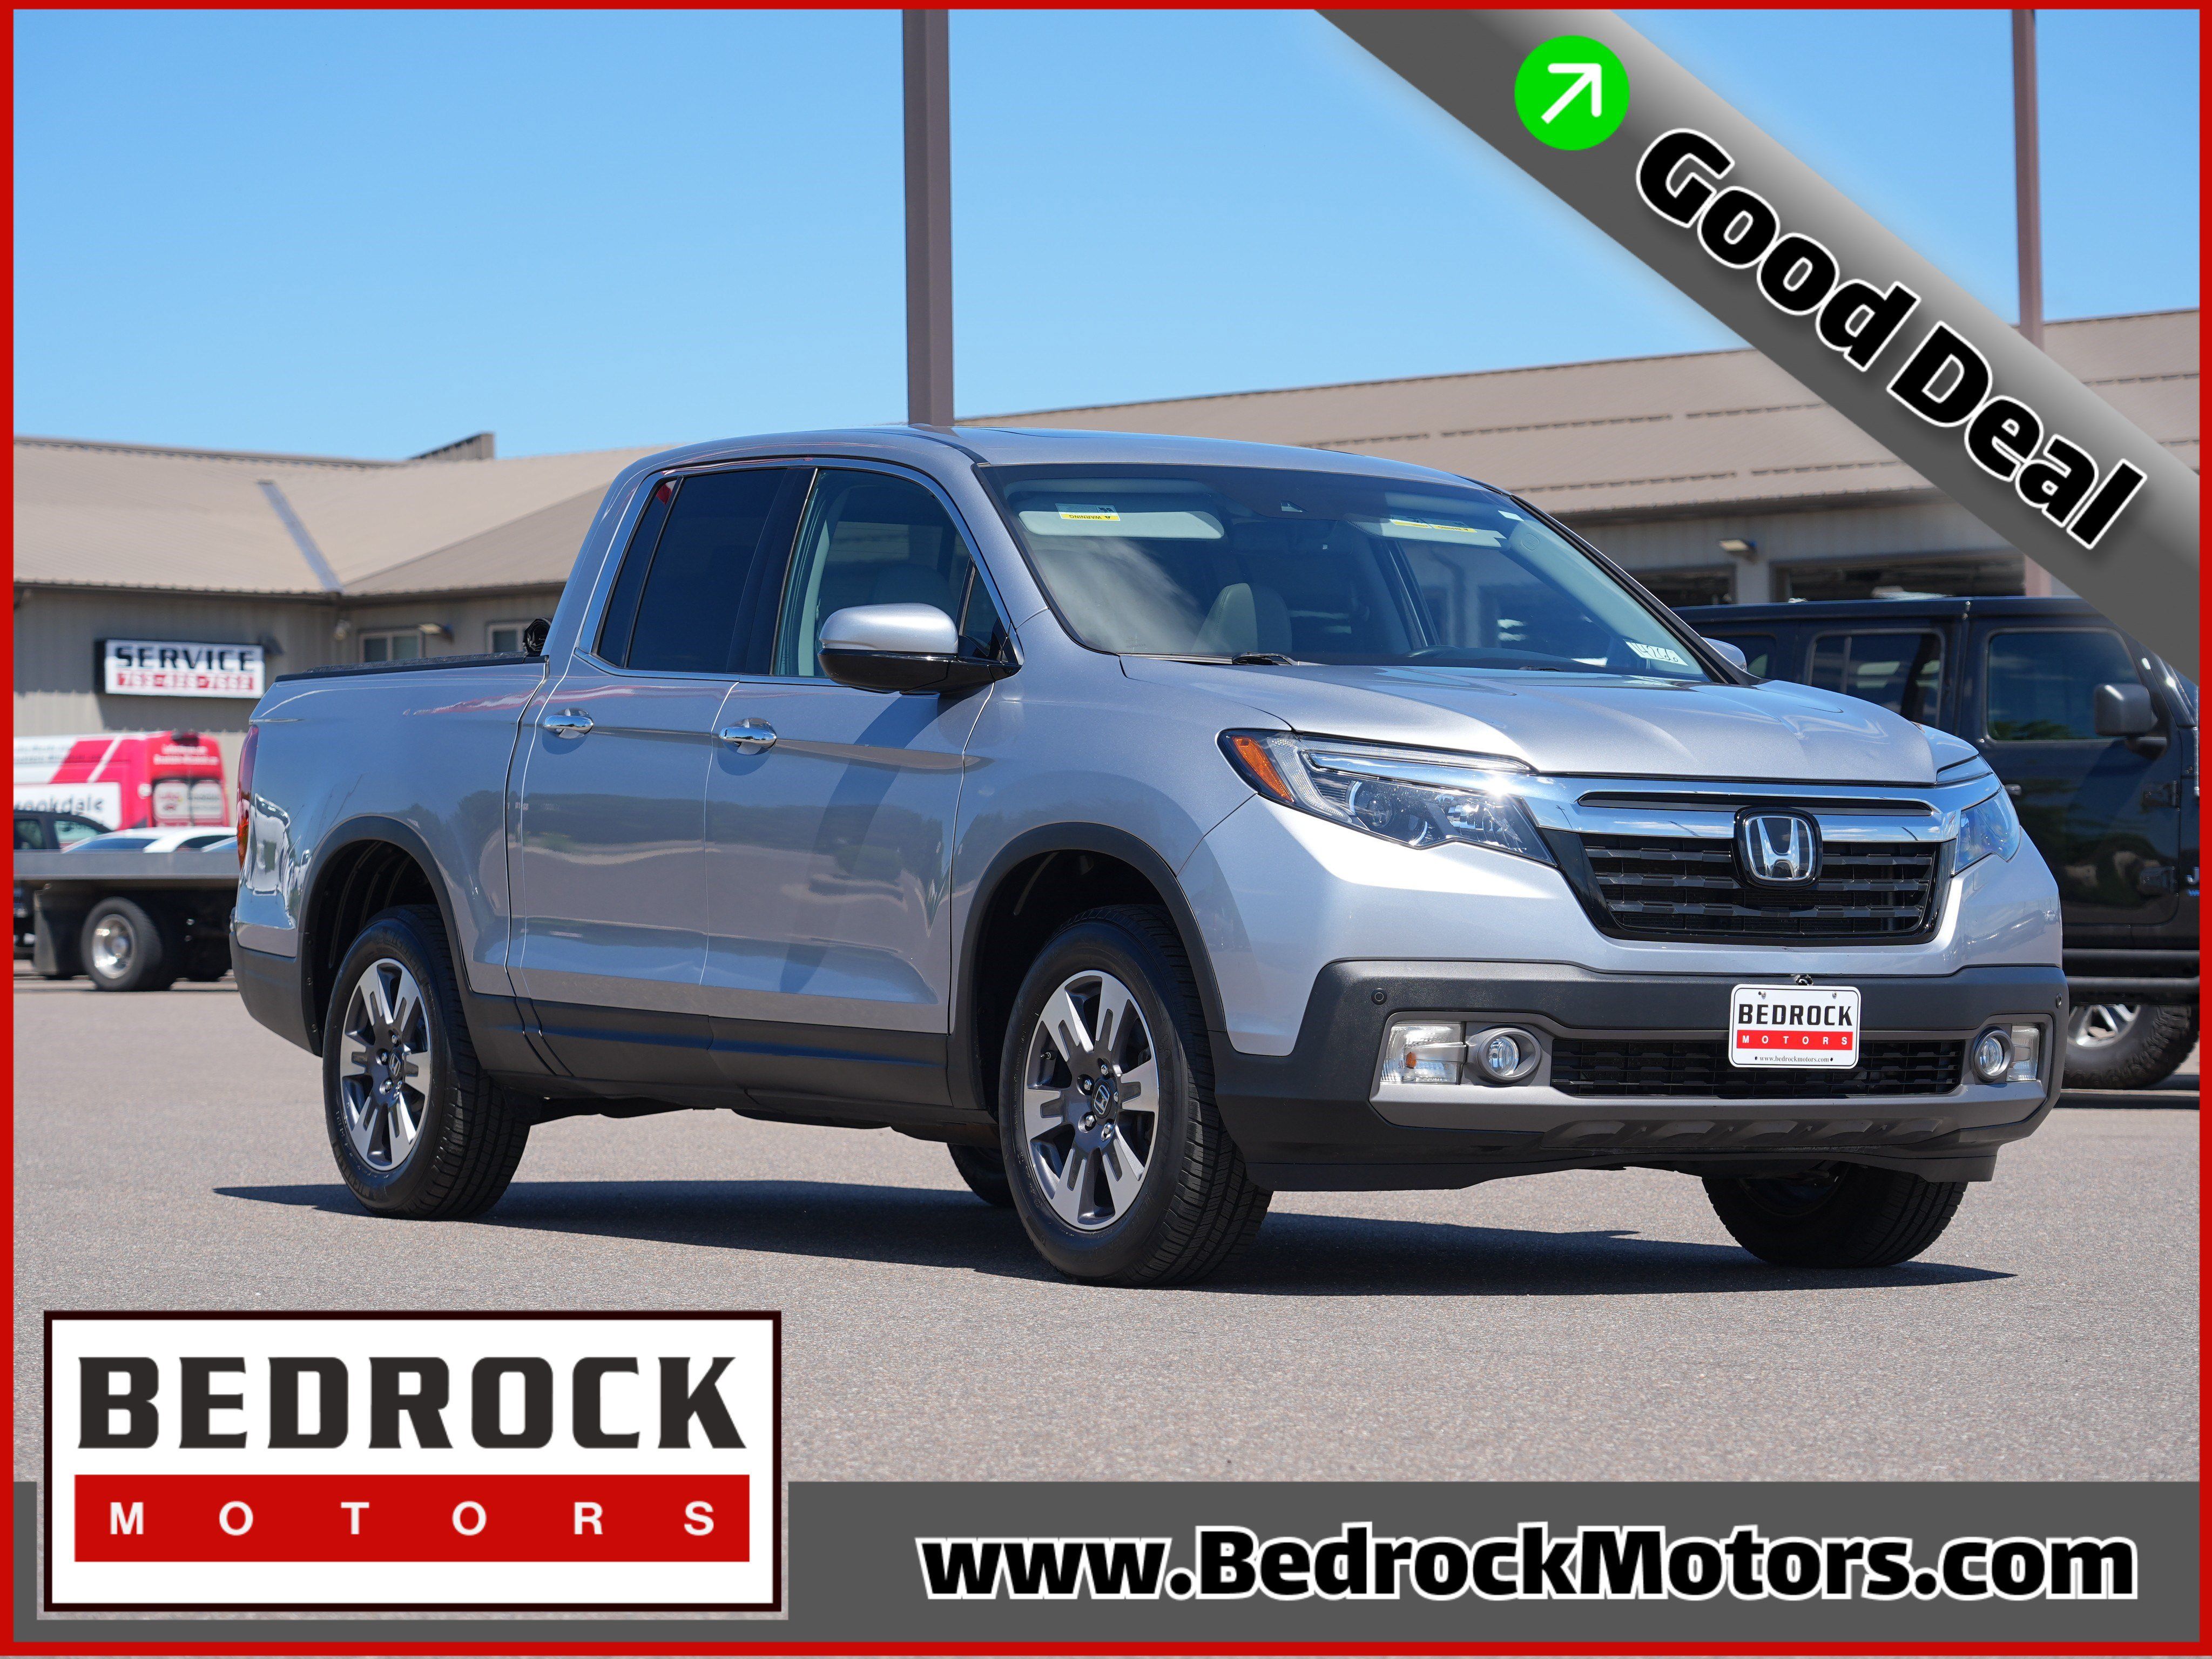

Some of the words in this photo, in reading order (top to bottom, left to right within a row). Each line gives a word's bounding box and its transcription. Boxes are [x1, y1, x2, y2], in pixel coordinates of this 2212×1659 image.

[116, 646, 254, 671] SERVICE
[14, 794, 104, 813] rookdale
[1738, 1003, 1853, 1026] BEDROCK
[1742, 1035, 1847, 1046] MOTORS
